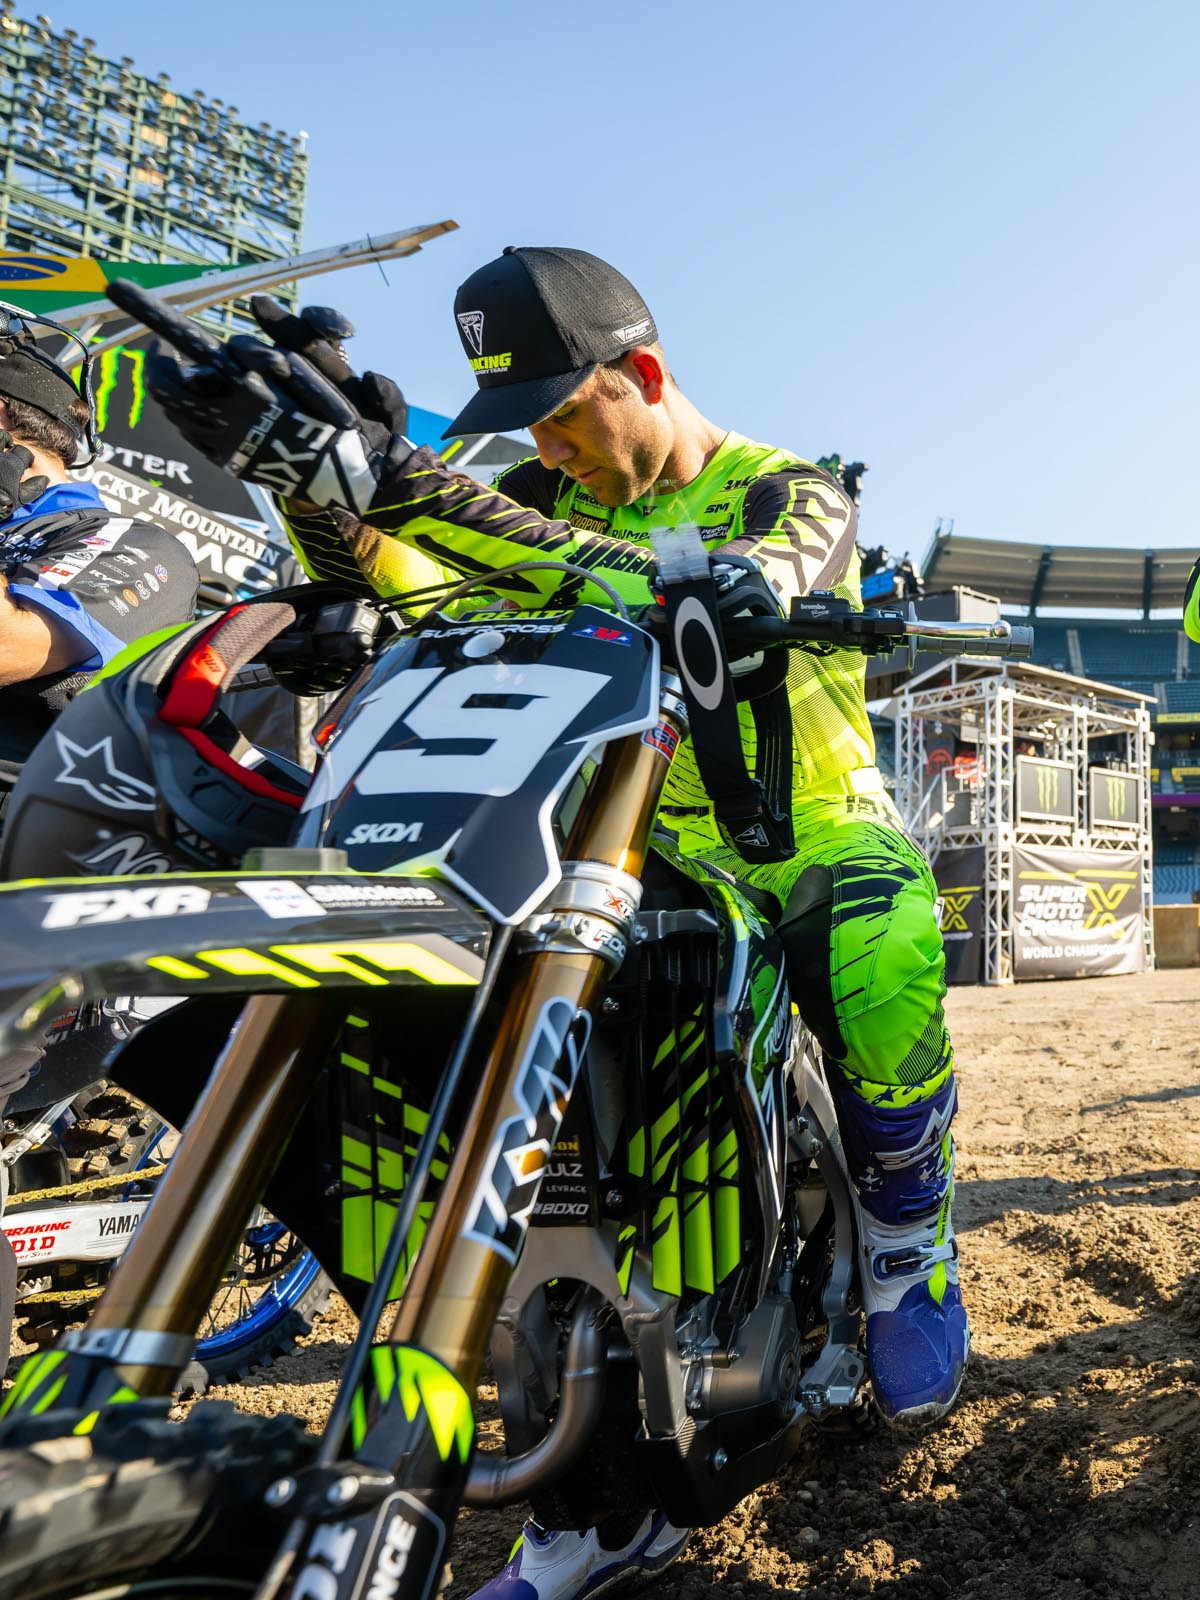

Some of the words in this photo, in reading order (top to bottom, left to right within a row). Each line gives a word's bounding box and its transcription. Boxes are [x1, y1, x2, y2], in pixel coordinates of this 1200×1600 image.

[64, 464, 150, 506] OCKY
[148, 492, 280, 566] MOUNTAIN
[417, 624, 567, 640] SUPERCROSS
[302, 664, 613, 798] 19
[344, 822, 424, 845] SKDA
[1018, 884, 1088, 903] SUPER
[1023, 902, 1084, 920] MOTO
[1022, 946, 1063, 960] WORLD
[541, 1202, 589, 1215] BOXO
